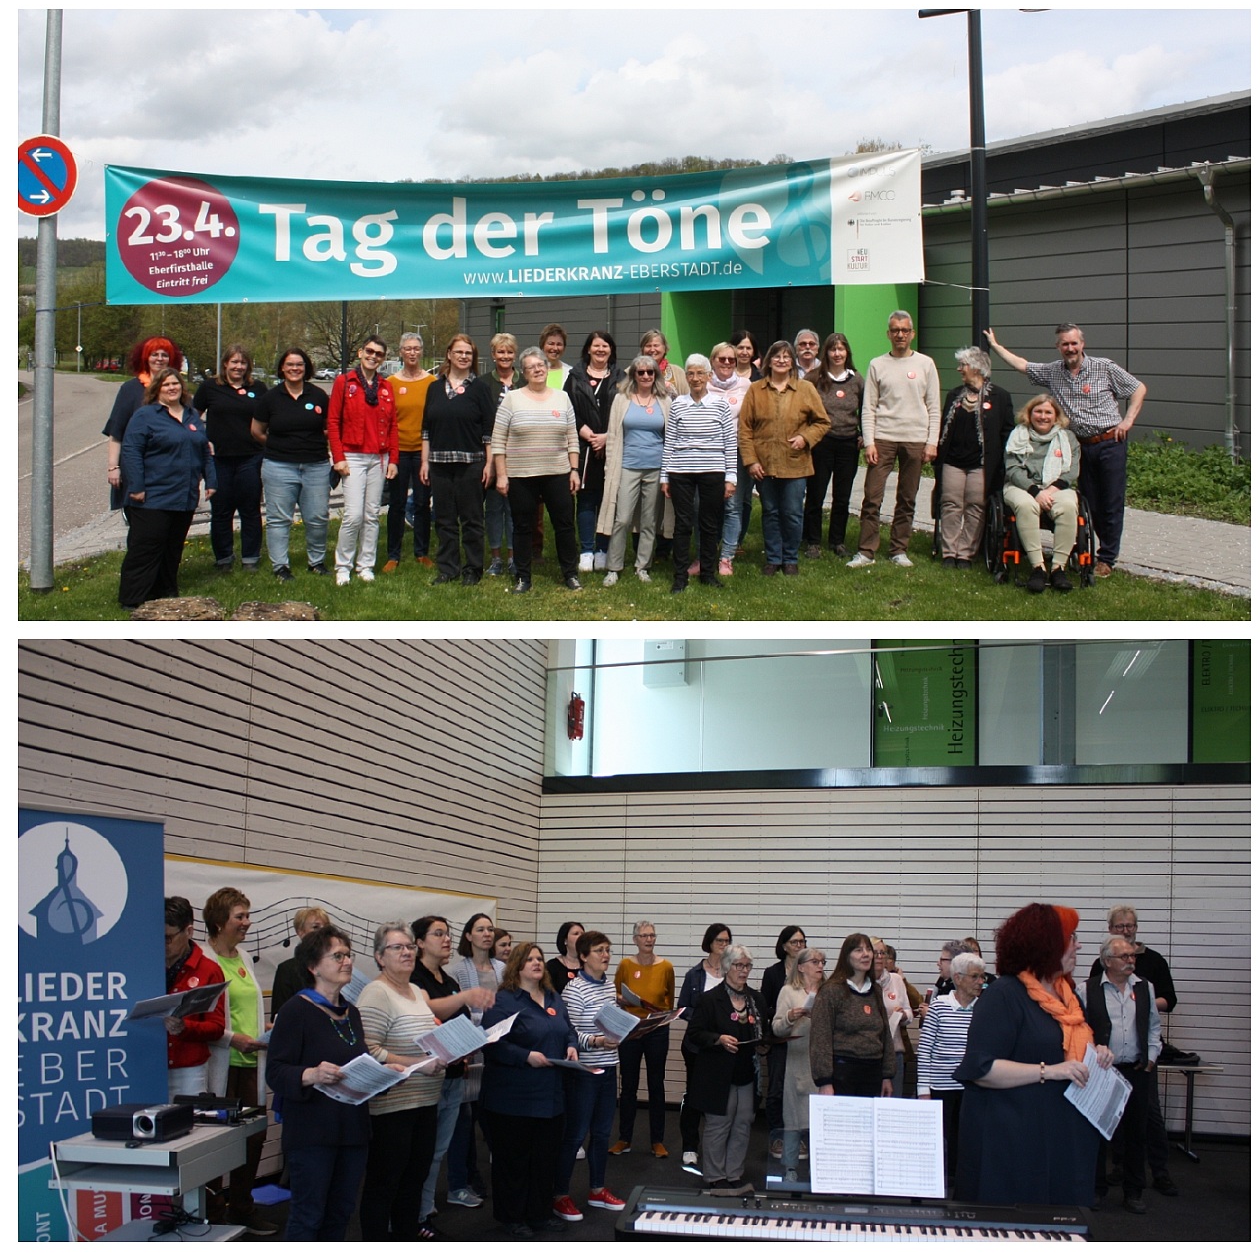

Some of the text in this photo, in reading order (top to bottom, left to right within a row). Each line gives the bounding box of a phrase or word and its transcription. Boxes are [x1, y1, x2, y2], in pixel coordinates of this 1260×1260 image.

[124, 200, 236, 246] 23.4.
[258, 189, 772, 278] Tag der Töne
[193, 248, 210, 257] Uhr
[149, 261, 214, 275] Eberfirsthalle
[463, 261, 742, 285] www.LIEDERKRANZ-EBERSTADT.de
[156, 275, 208, 289] Eintritt frei
